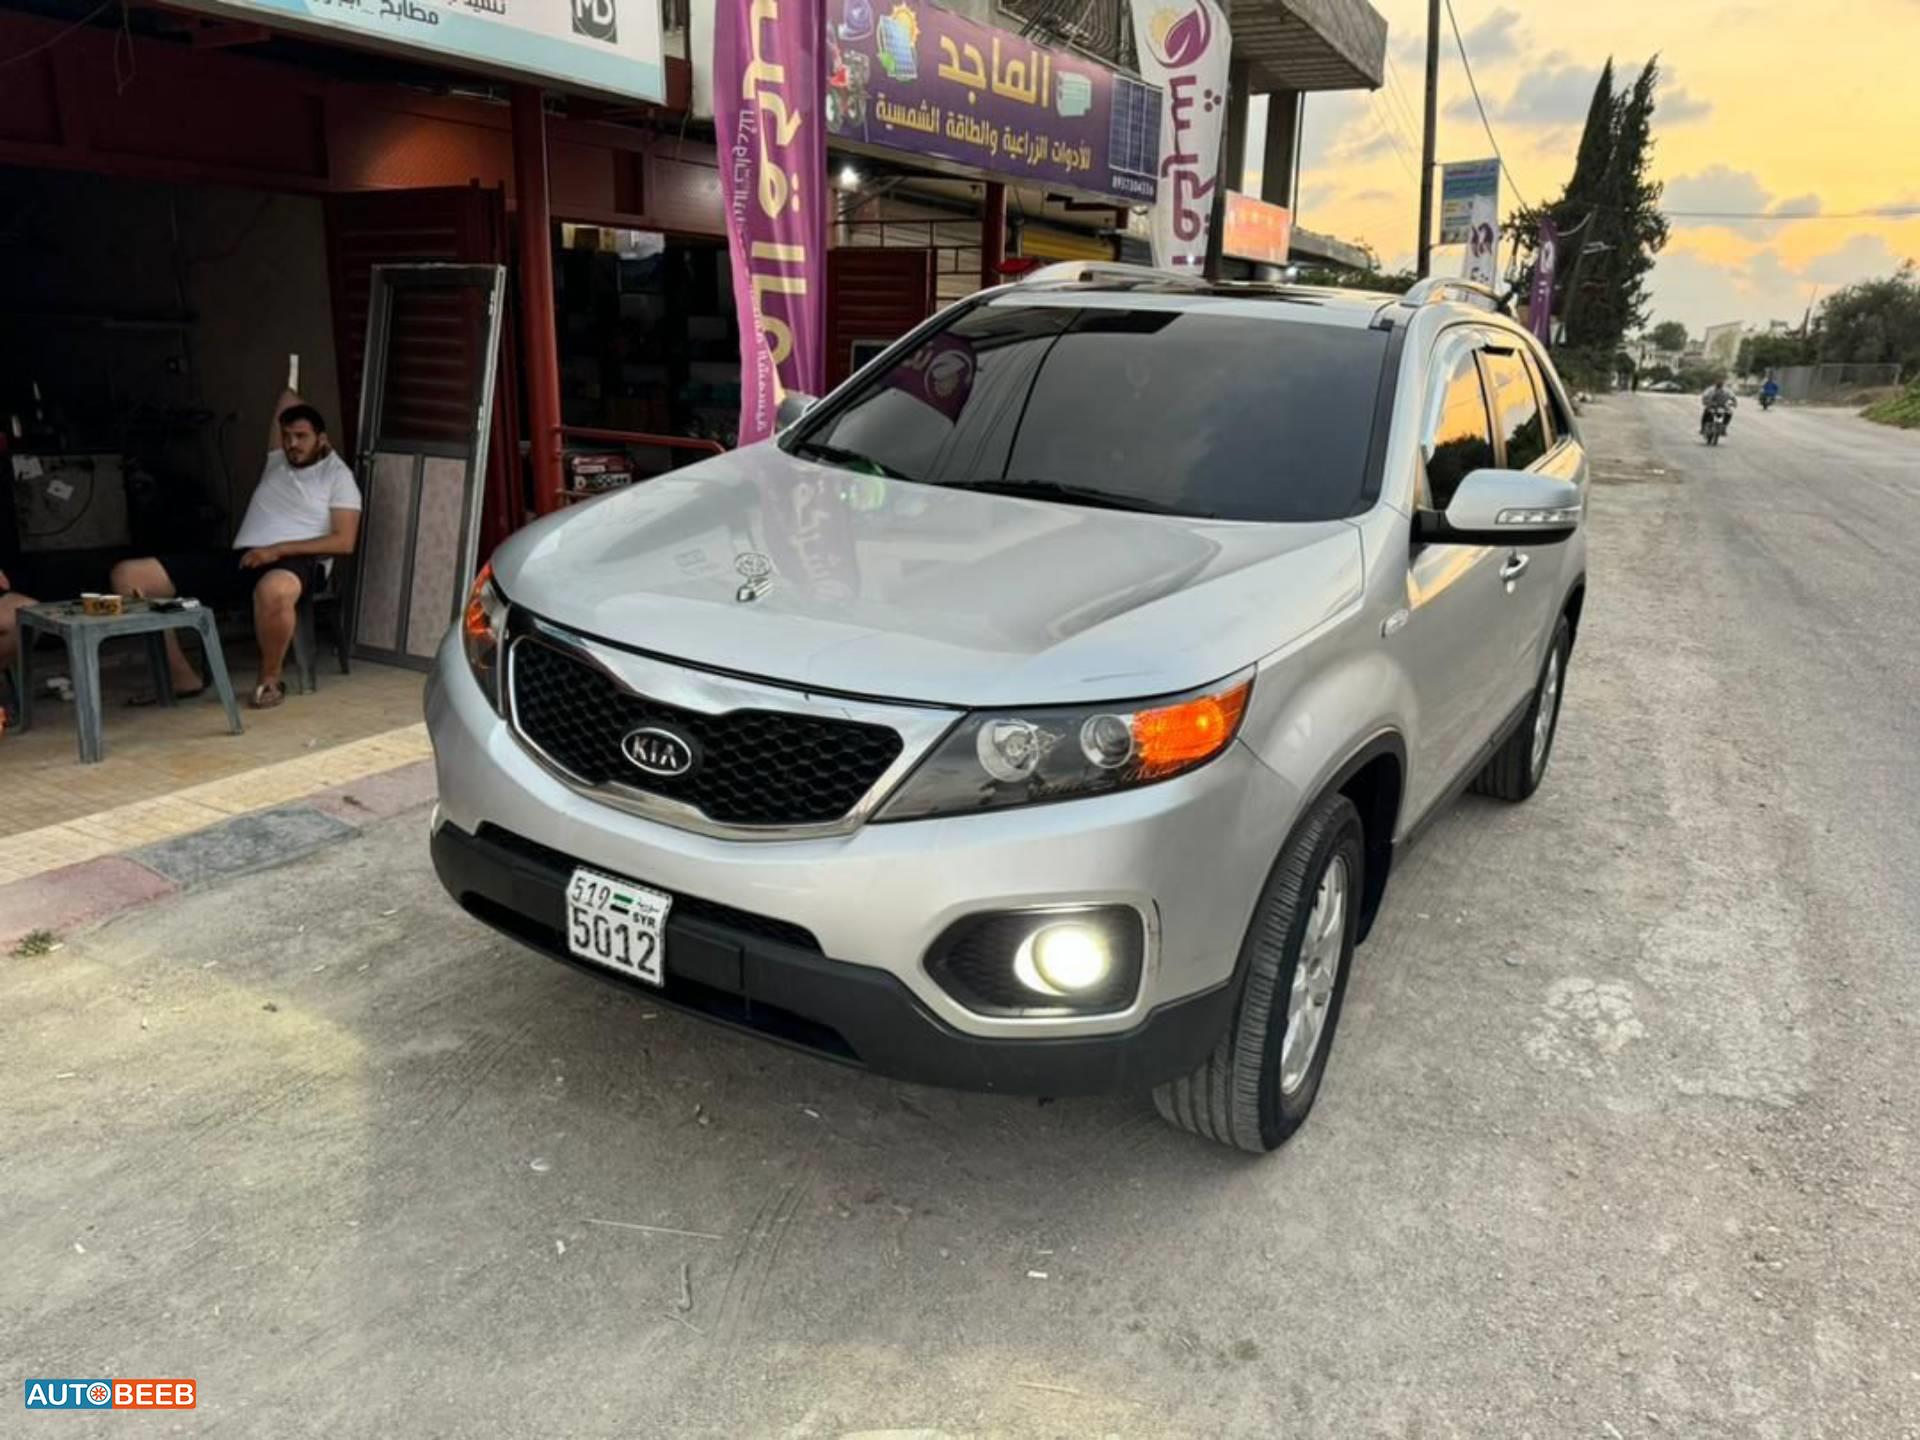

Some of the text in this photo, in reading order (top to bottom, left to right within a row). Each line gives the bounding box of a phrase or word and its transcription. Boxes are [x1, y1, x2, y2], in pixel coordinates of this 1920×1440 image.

[937, 34, 1050, 108] الماجد
[875, 91, 1091, 173] للأدوات الزراعية والطاقة الشمسية
[632, 735, 678, 769] KIA
[571, 876, 611, 911] 519
[572, 905, 656, 977] 5012
[632, 912, 656, 929] SYR
